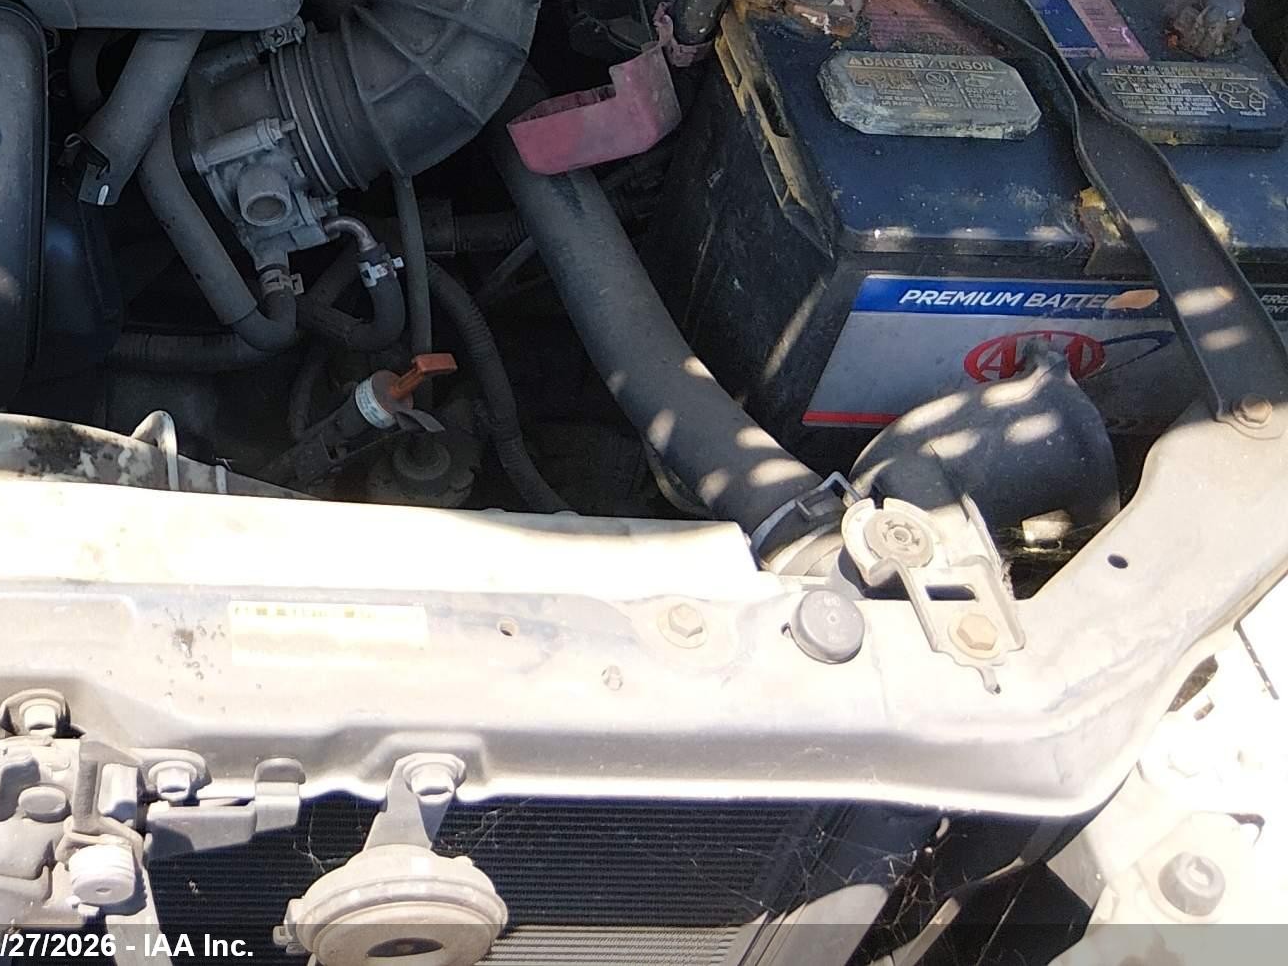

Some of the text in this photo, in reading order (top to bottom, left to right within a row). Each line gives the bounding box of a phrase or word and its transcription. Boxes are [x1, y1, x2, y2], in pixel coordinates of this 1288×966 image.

[863, 57, 924, 69] DANGER
[939, 60, 994, 71] POISON
[899, 290, 1117, 309] PREMIUM BATTE
